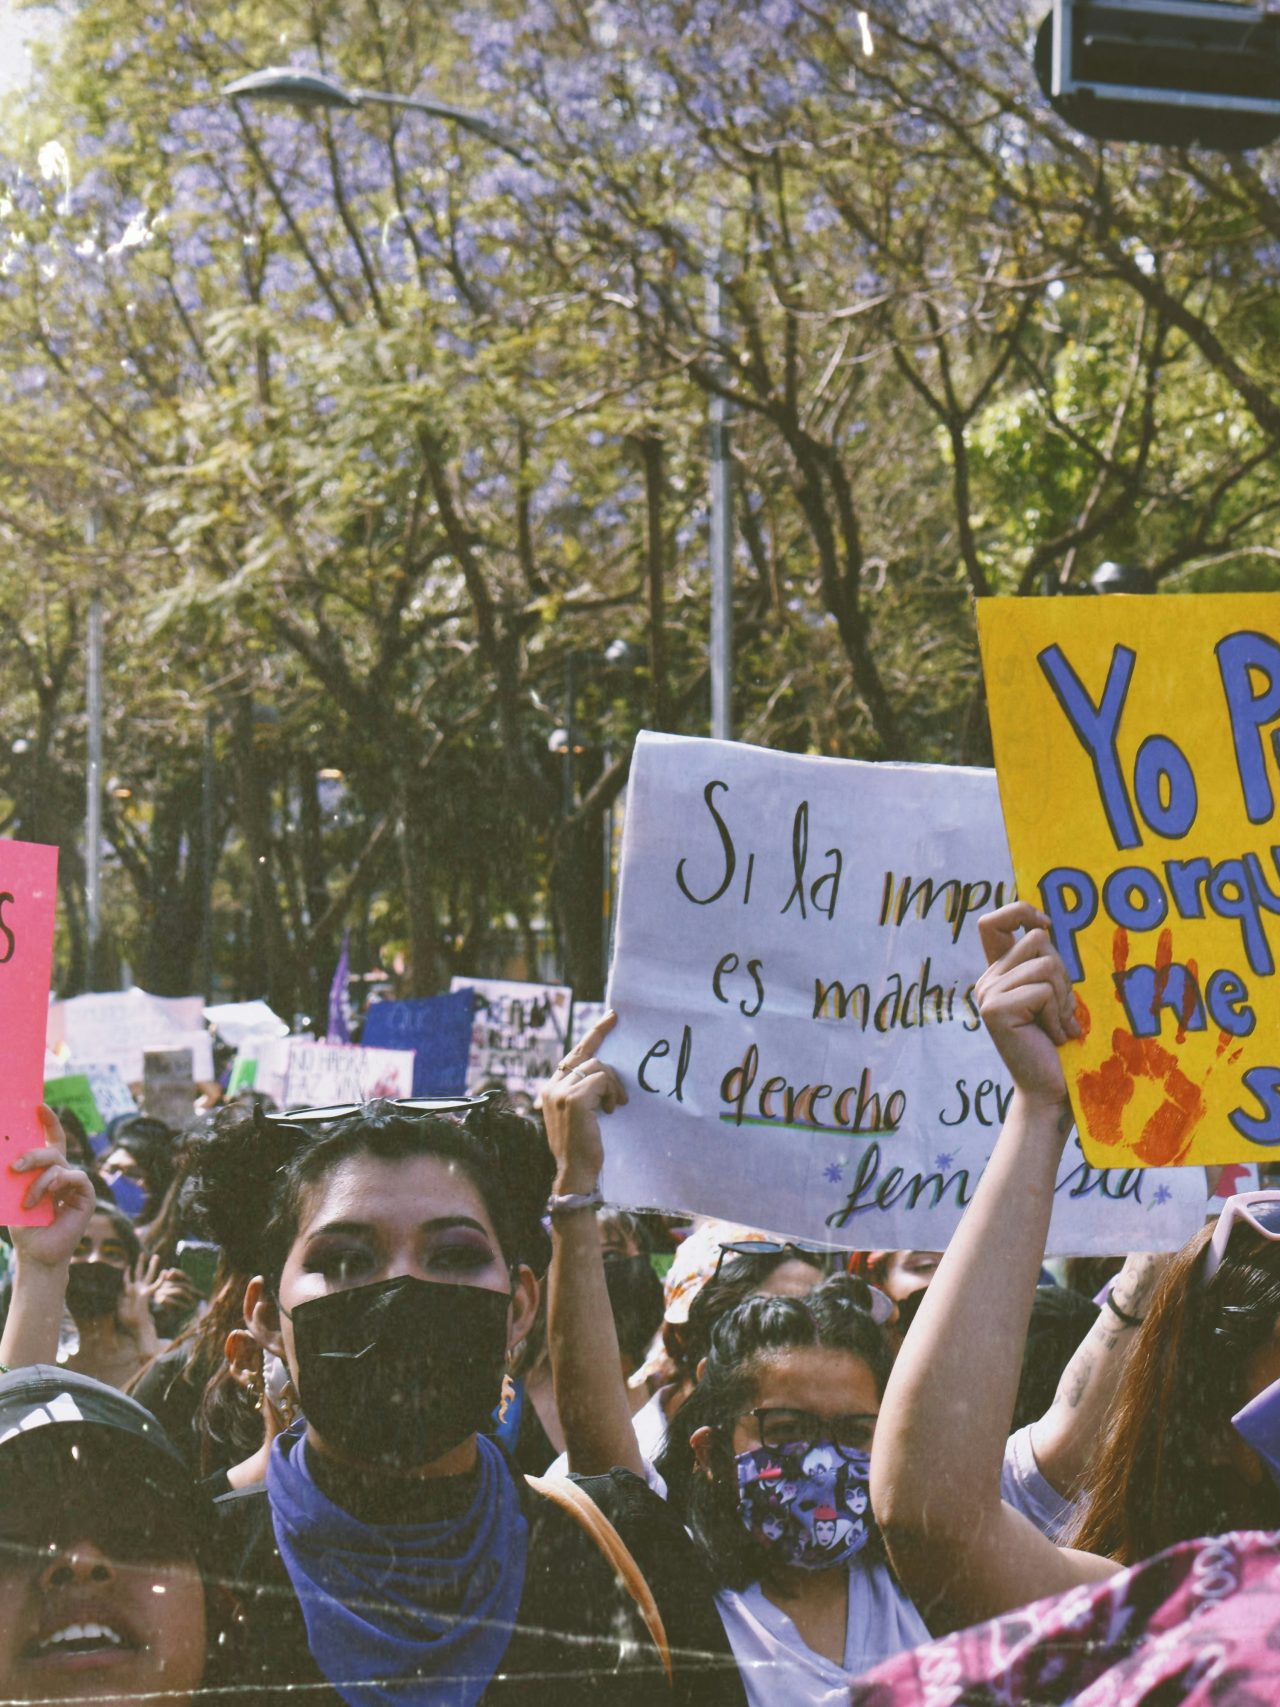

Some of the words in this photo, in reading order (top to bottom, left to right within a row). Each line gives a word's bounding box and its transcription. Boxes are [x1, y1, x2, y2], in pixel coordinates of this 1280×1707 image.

[1036, 642, 1198, 850] Yo
[676, 780, 754, 905] Si
[780, 800, 844, 920] la
[711, 952, 765, 1017] es
[1113, 963, 1257, 1038] me
[637, 1025, 693, 1102] el
[719, 1043, 908, 1132] derecho
